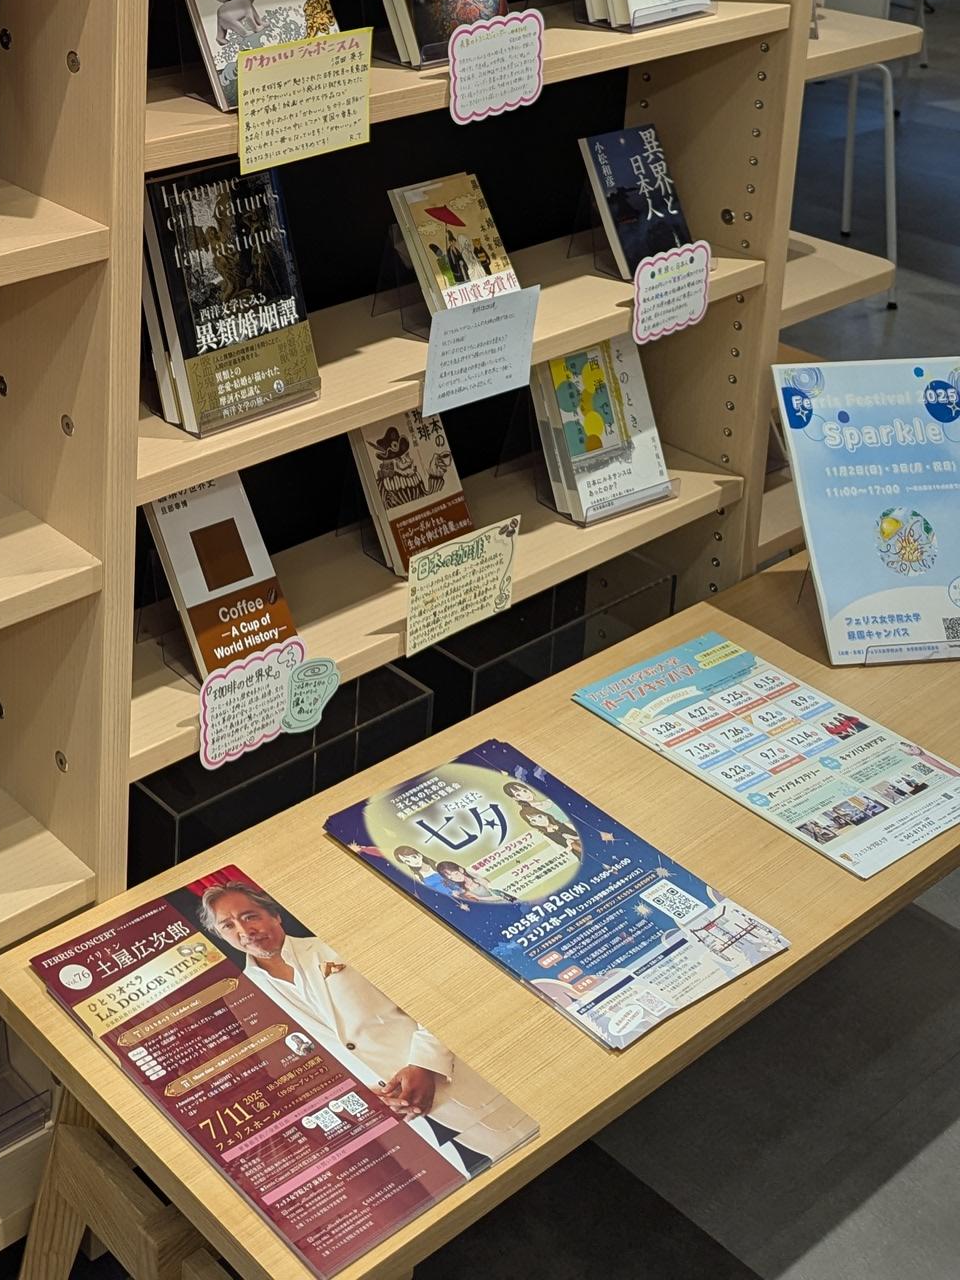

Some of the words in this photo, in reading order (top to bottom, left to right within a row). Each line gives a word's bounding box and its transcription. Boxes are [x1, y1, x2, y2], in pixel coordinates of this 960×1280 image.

[629, 156, 664, 221] 日本人
[639, 128, 679, 215] 異界と
[161, 177, 240, 208] Homme
[174, 225, 287, 268] fantastiques
[200, 293, 267, 322] 西洋文学にみる
[444, 272, 518, 308] 芥川賞受賞作
[196, 296, 299, 355] 異類婚姻譚
[916, 388, 957, 404] 2025
[823, 417, 943, 453] Sparkle
[219, 598, 264, 622] Coffee
[240, 620, 259, 633] Cup
[261, 613, 271, 625] of
[845, 613, 920, 626] フェリス女学院大学
[214, 640, 243, 659] World
[847, 627, 910, 640] 緑園キャンパス
[768, 769, 822, 799] オープンライブラリー
[443, 792, 483, 813] たなばた
[416, 804, 508, 850] 七夕
[512, 857, 541, 877] コンサート
[502, 882, 590, 939] 2025年7月2日(水)
[517, 907, 577, 947] フェリスホール
[41, 944, 76, 969] FERRIS
[75, 928, 116, 956] CONCERT
[86, 943, 121, 964] バリトン
[95, 920, 191, 980] 土屋広次郎
[87, 975, 143, 1013] ひとりオペラ
[96, 1003, 118, 1022] LA
[116, 977, 167, 1010] DOLCE
[198, 1102, 253, 1140] 7/11
[243, 1090, 263, 1107] 2025
[215, 1109, 280, 1151] フェリスホール
